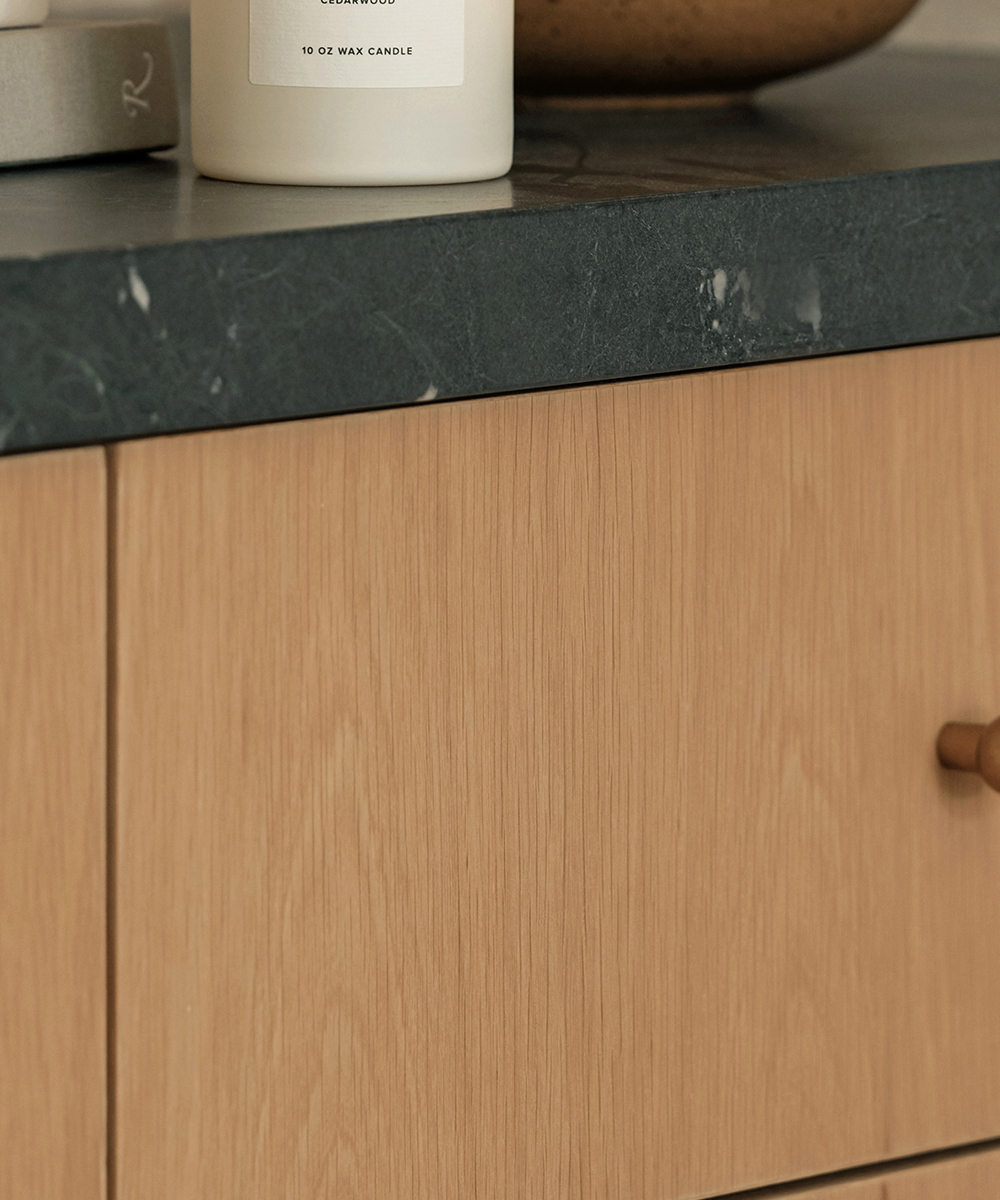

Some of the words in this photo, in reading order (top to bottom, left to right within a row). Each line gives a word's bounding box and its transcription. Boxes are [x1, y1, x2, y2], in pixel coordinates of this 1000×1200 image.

[301, 46, 314, 55] 10
[317, 46, 333, 56] OZ
[337, 46, 364, 56] WAX
[367, 46, 413, 56] CANDLE
